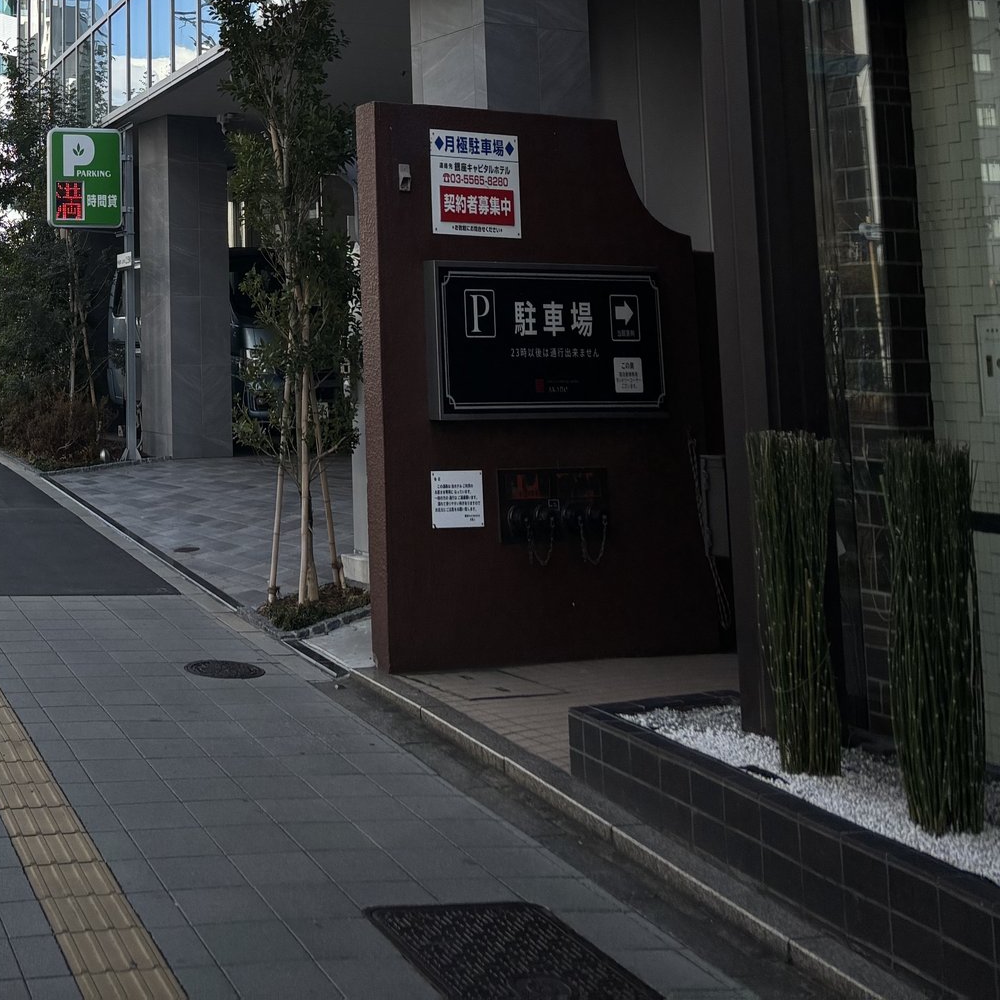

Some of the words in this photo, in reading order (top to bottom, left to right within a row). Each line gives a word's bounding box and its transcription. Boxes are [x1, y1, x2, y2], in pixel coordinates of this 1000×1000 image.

[63, 134, 95, 176] P
[444, 135, 504, 157] 月極駐車場
[76, 170, 111, 178] PARKING
[450, 173, 508, 186] 03-5565-8280
[454, 162, 511, 175] 銀座キャピタルホテル
[56, 182, 82, 219] 満
[86, 193, 117, 207] 時間貸
[443, 193, 512, 217] 契約者募集中
[470, 294, 490, 333] P
[514, 301, 593, 337] 駐車場
[510, 347, 600, 358] 23時以後は通行出来ません
